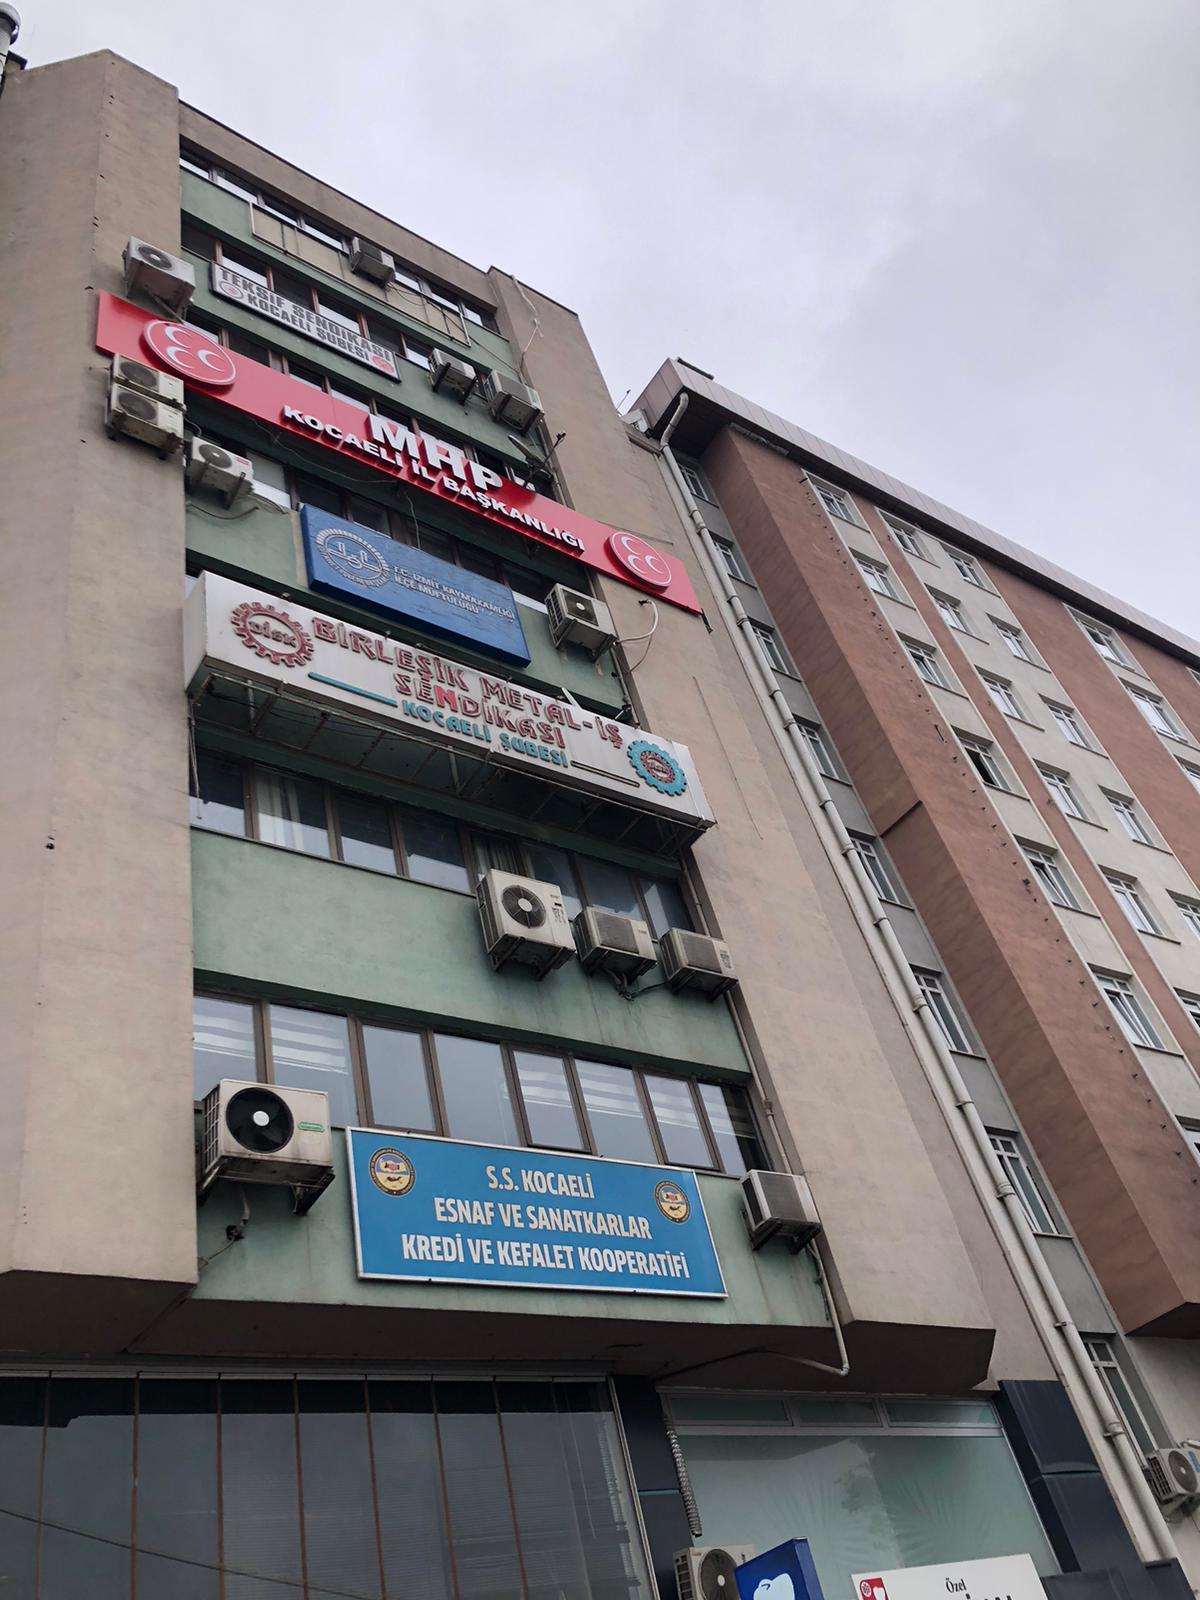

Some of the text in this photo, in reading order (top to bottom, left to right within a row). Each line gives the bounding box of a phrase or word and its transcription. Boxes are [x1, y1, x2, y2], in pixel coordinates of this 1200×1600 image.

[283, 405, 585, 551] KOCAELİ İL BAŞKANLIĞI
[369, 414, 503, 490] MHP
[312, 617, 624, 749] BİRLEŞİK METAL-İŞ
[393, 672, 566, 748] SENDİKASI
[402, 699, 569, 768] KOCAELİ ŞUBESİ
[486, 1165, 595, 1199] S.S. KOCAELİ
[434, 1197, 653, 1241] ESNAF VE SANATKARLAR
[401, 1233, 691, 1279] KREDİ VE KEFALET KOOPERATİFİ
[945, 1577, 967, 1594] Özel
